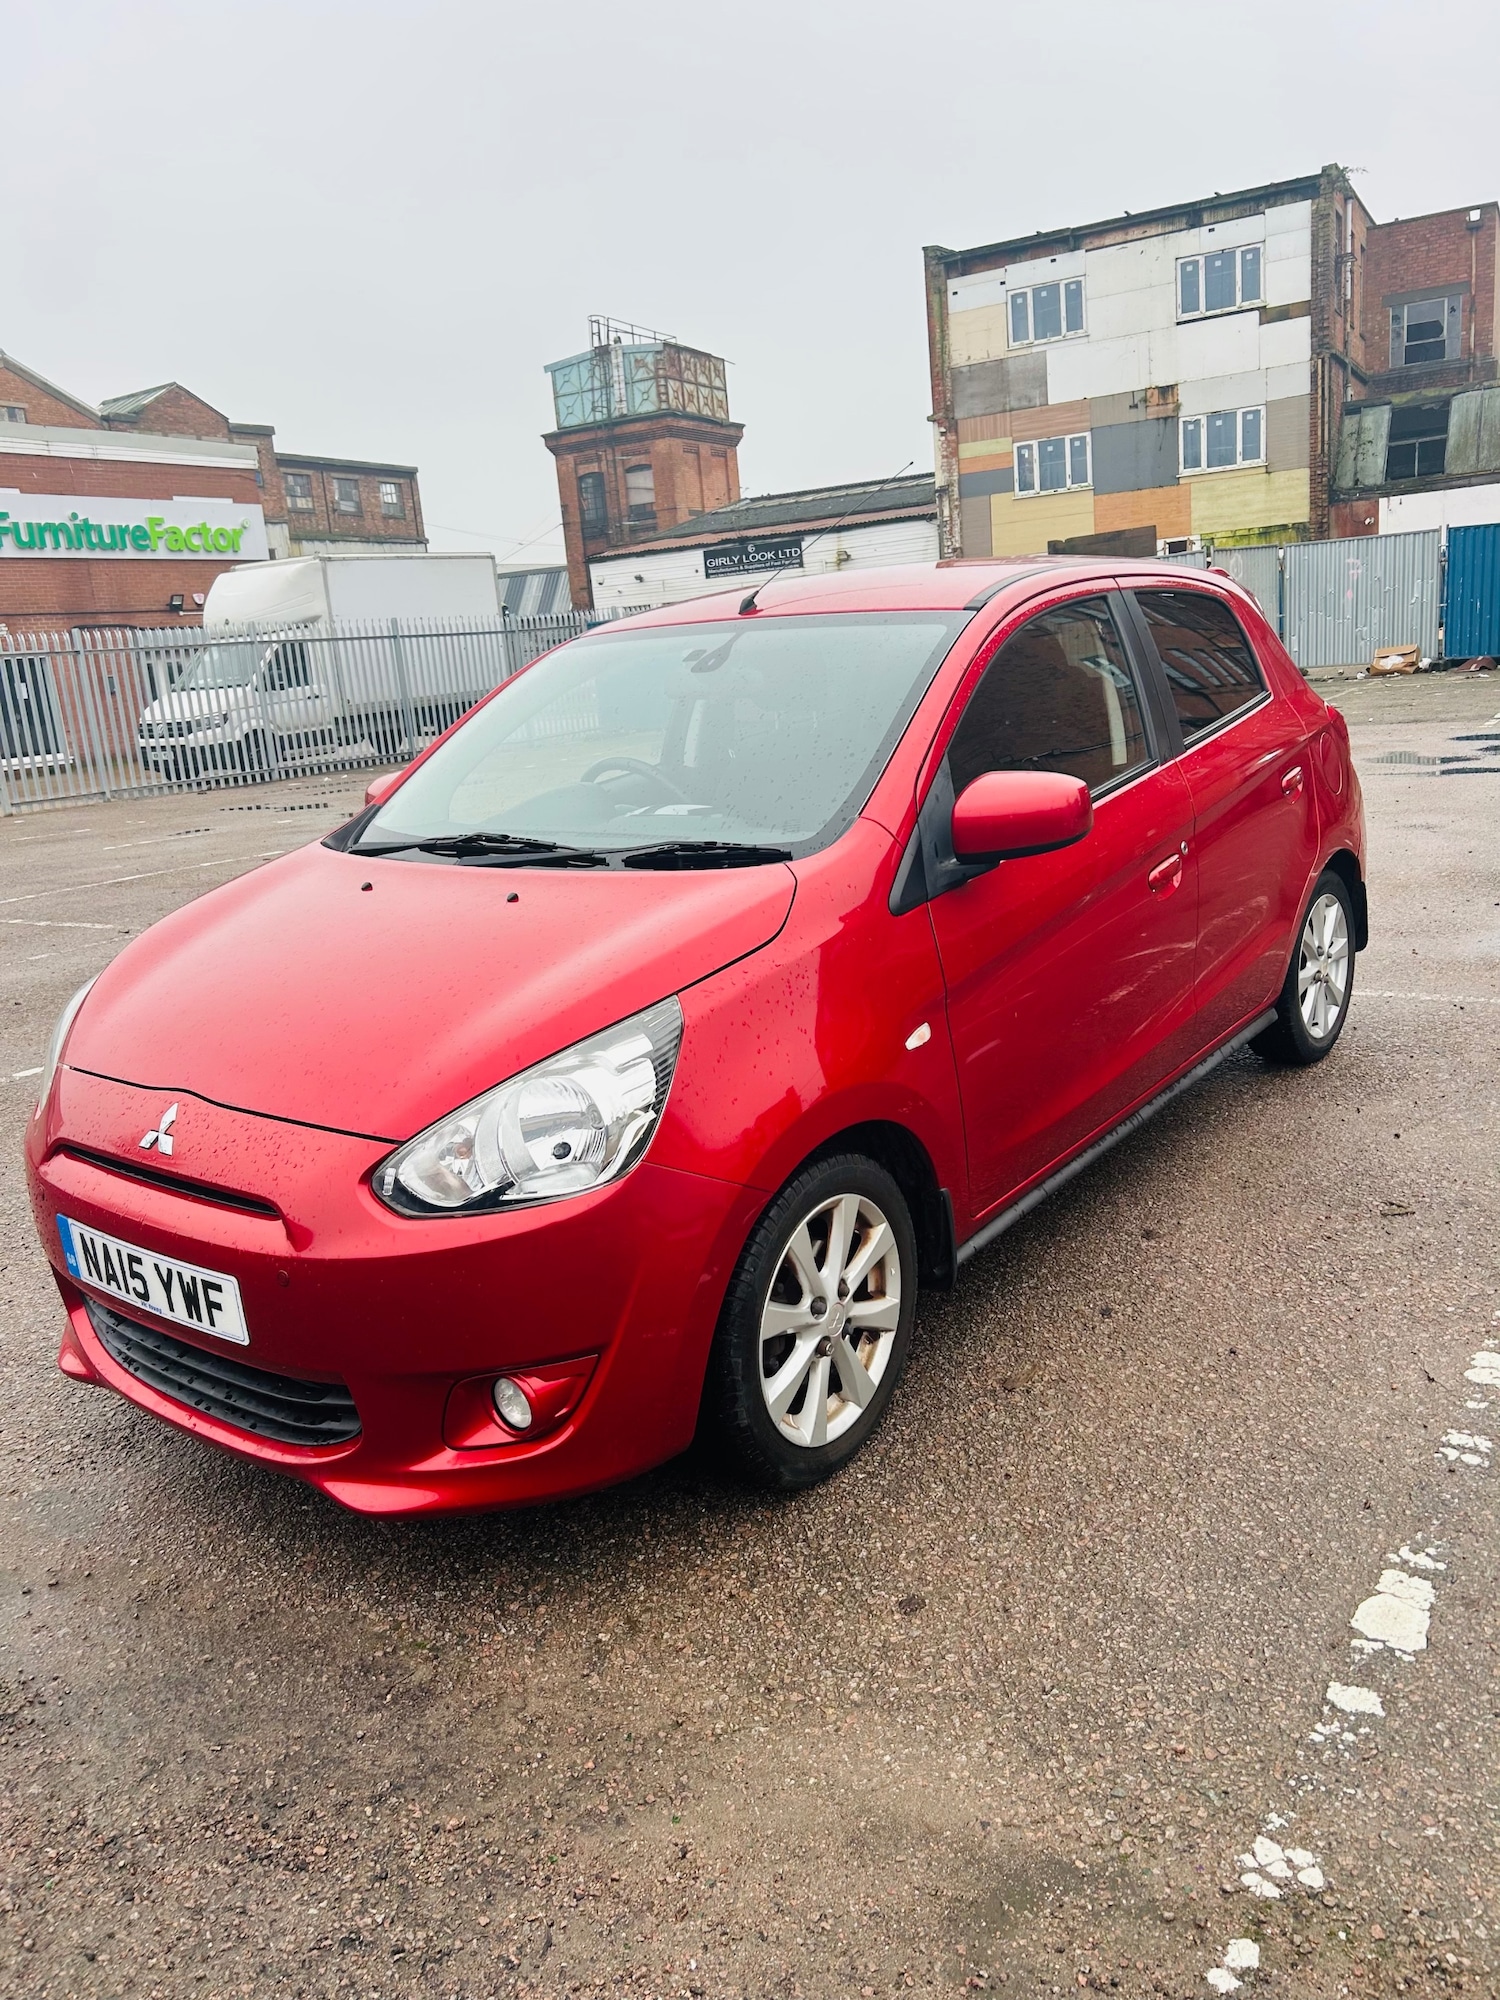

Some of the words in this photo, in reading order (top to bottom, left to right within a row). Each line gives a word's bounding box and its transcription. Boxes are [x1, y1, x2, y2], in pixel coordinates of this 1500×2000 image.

[706, 555, 740, 567] GIRLY
[742, 550, 776, 563] LOOK
[778, 547, 801, 558] LTD
[79, 1232, 150, 1301] NA15
[153, 1262, 223, 1328] YWF
